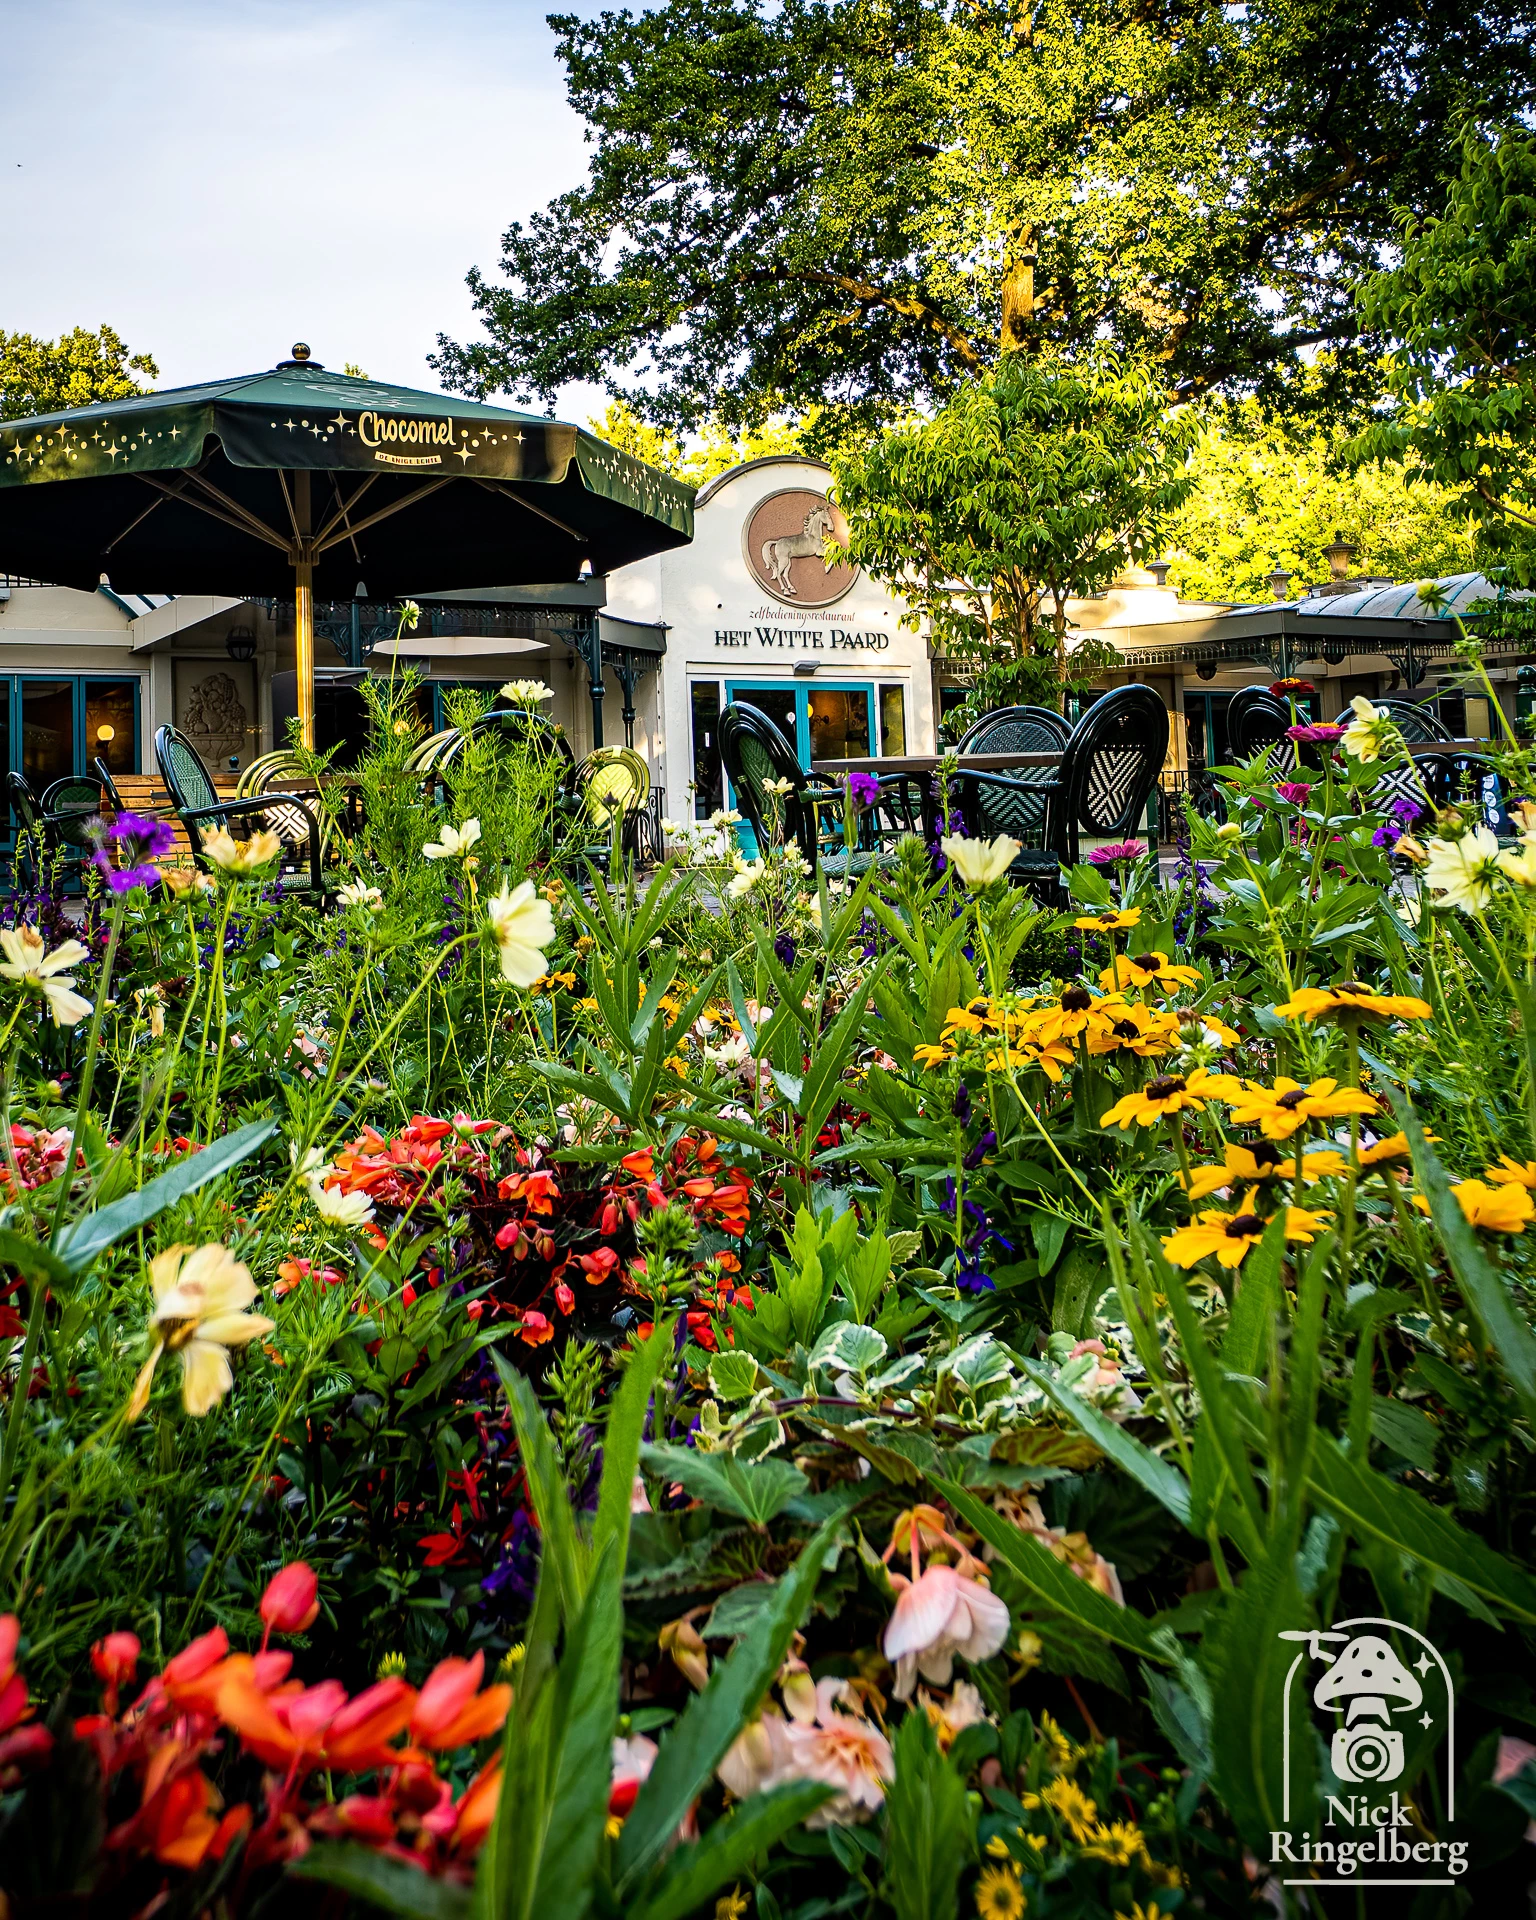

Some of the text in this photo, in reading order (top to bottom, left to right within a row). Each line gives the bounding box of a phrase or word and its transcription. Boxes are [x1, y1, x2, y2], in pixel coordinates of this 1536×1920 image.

[358, 411, 457, 447] Chocomel
[749, 606, 856, 629] zelfbedieningsrestaurant
[714, 626, 889, 654] HET WITTE PAARD
